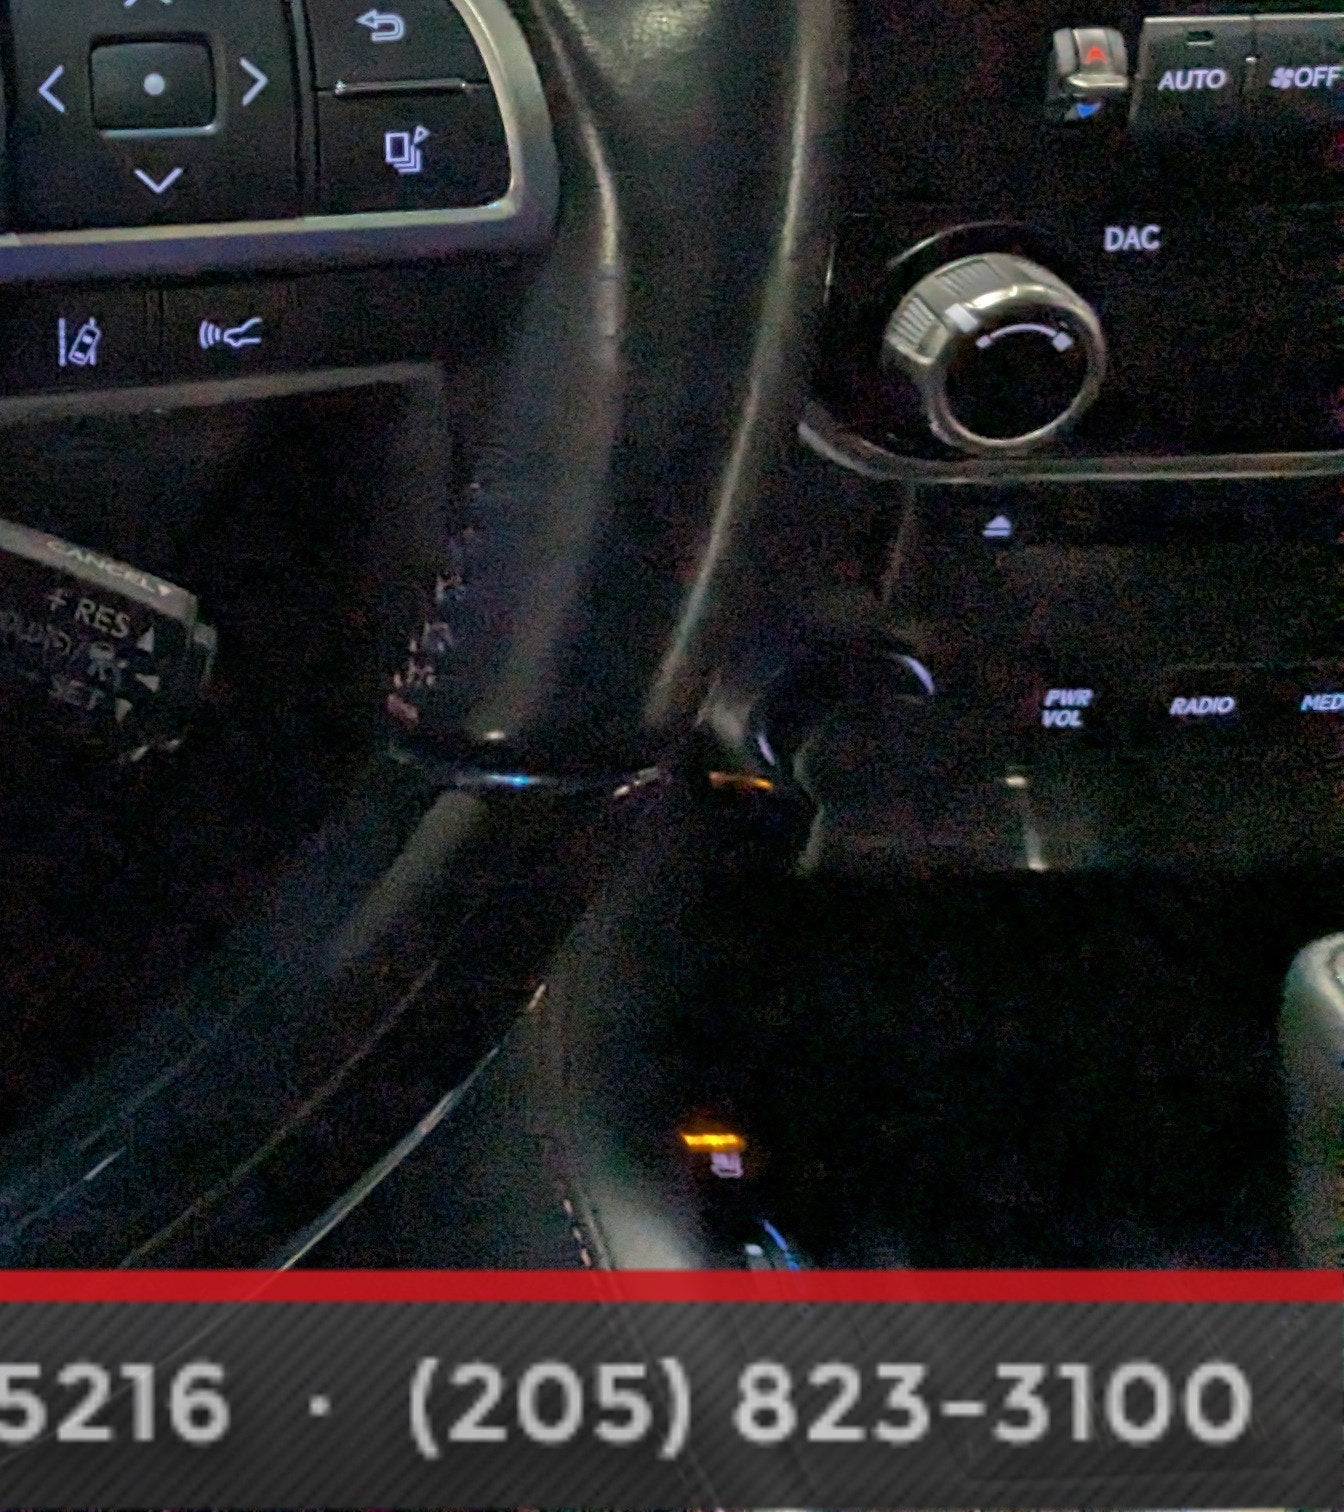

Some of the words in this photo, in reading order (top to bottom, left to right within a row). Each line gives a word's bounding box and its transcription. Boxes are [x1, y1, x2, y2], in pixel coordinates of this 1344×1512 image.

[1157, 68, 1227, 91] AUTO
[1294, 65, 1343, 89] OFF
[1103, 224, 1161, 252] DAC
[74, 598, 131, 638] RES
[1044, 688, 1093, 707] PWR
[1169, 695, 1235, 716] RADIO
[1042, 709, 1082, 728] VOL
